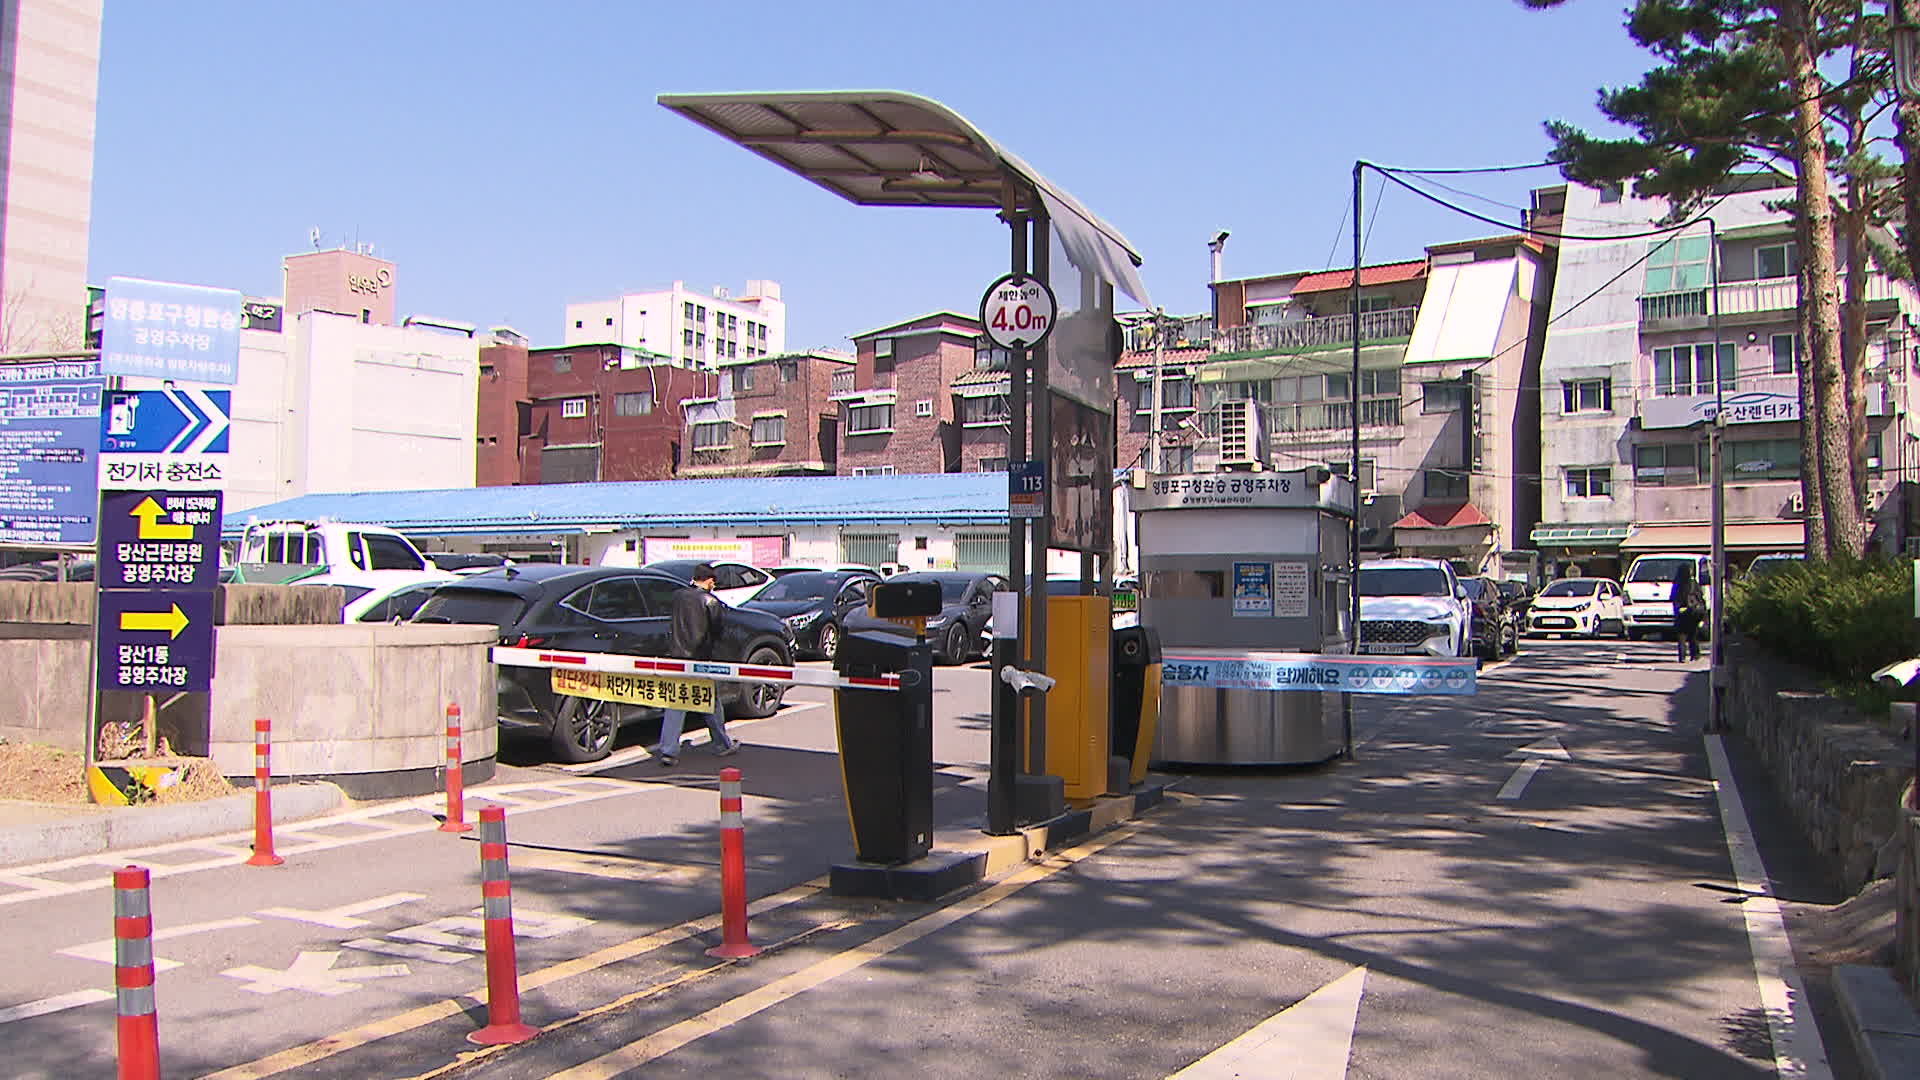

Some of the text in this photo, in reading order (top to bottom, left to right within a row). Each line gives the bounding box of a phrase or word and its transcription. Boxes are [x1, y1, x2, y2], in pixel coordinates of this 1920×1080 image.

[998, 288, 1039, 301] 제한높이
[991, 304, 1047, 331] 4.0m
[135, 328, 210, 351] 공영주차장
[107, 461, 222, 482] 전기차 충전소
[1022, 476, 1043, 491] 113
[1152, 477, 1291, 496] 영등포구청환승 공영주차장
[117, 543, 203, 562] 당산근린공원
[123, 564, 195, 583] 공영주차장
[118, 645, 169, 664] 당산1동
[118, 665, 188, 686] 공영주차장
[1162, 663, 1208, 682] 승용차
[1275, 666, 1340, 686] 함께해요
[556, 668, 713, 707] 일단정지 차단기 작동 확인 후 통과
